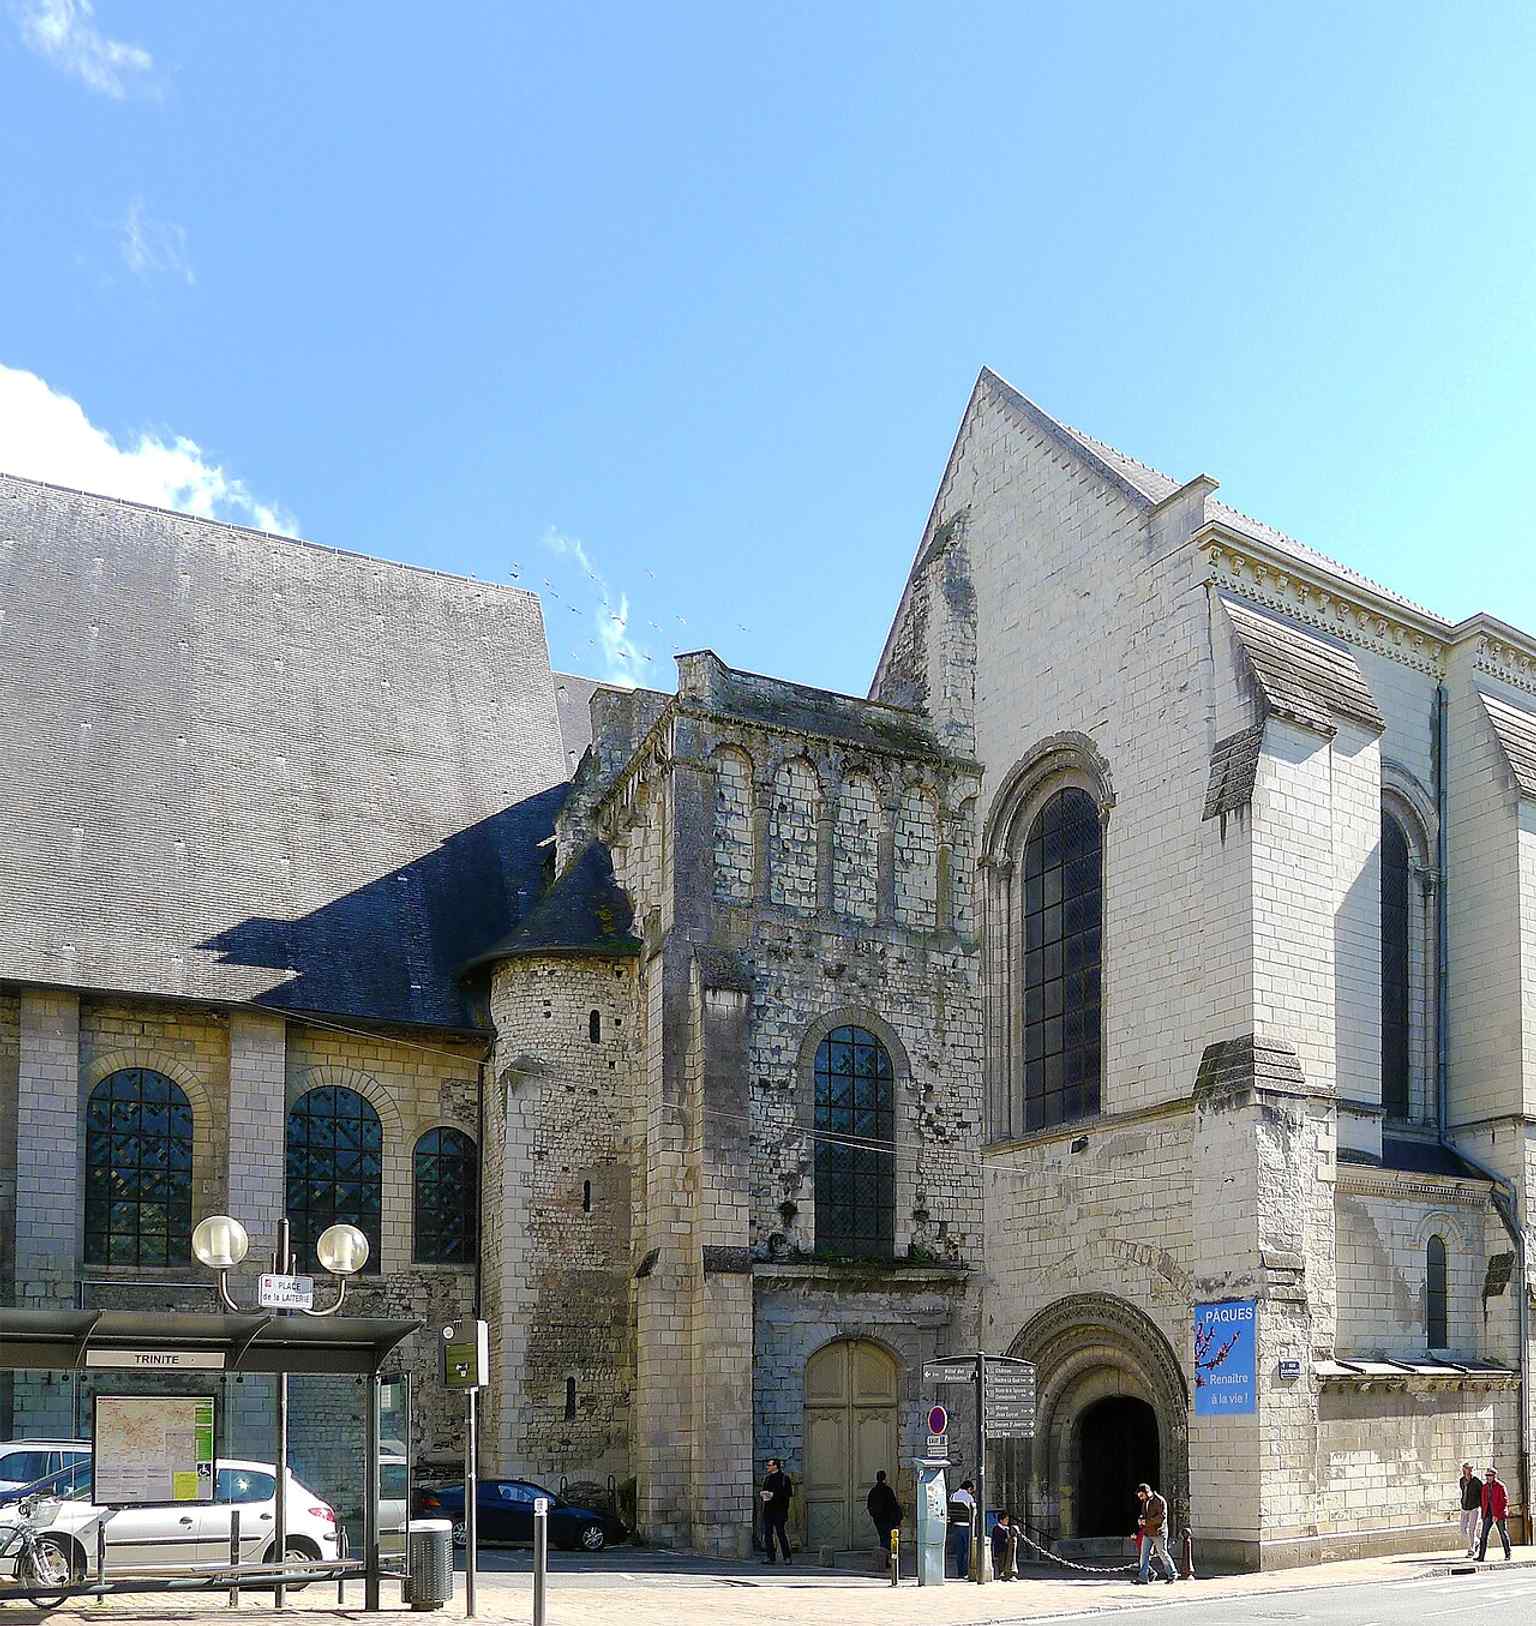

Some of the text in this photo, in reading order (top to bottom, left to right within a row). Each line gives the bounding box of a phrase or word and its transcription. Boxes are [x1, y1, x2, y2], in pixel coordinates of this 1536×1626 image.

[278, 1281, 302, 1291] PLACE
[1205, 1307, 1253, 1323] PÂQUES
[135, 1354, 179, 1365] TRINITE
[1210, 1373, 1248, 1385] Renaître
[1211, 1394, 1217, 1405] à
[1219, 1393, 1228, 1404] la
